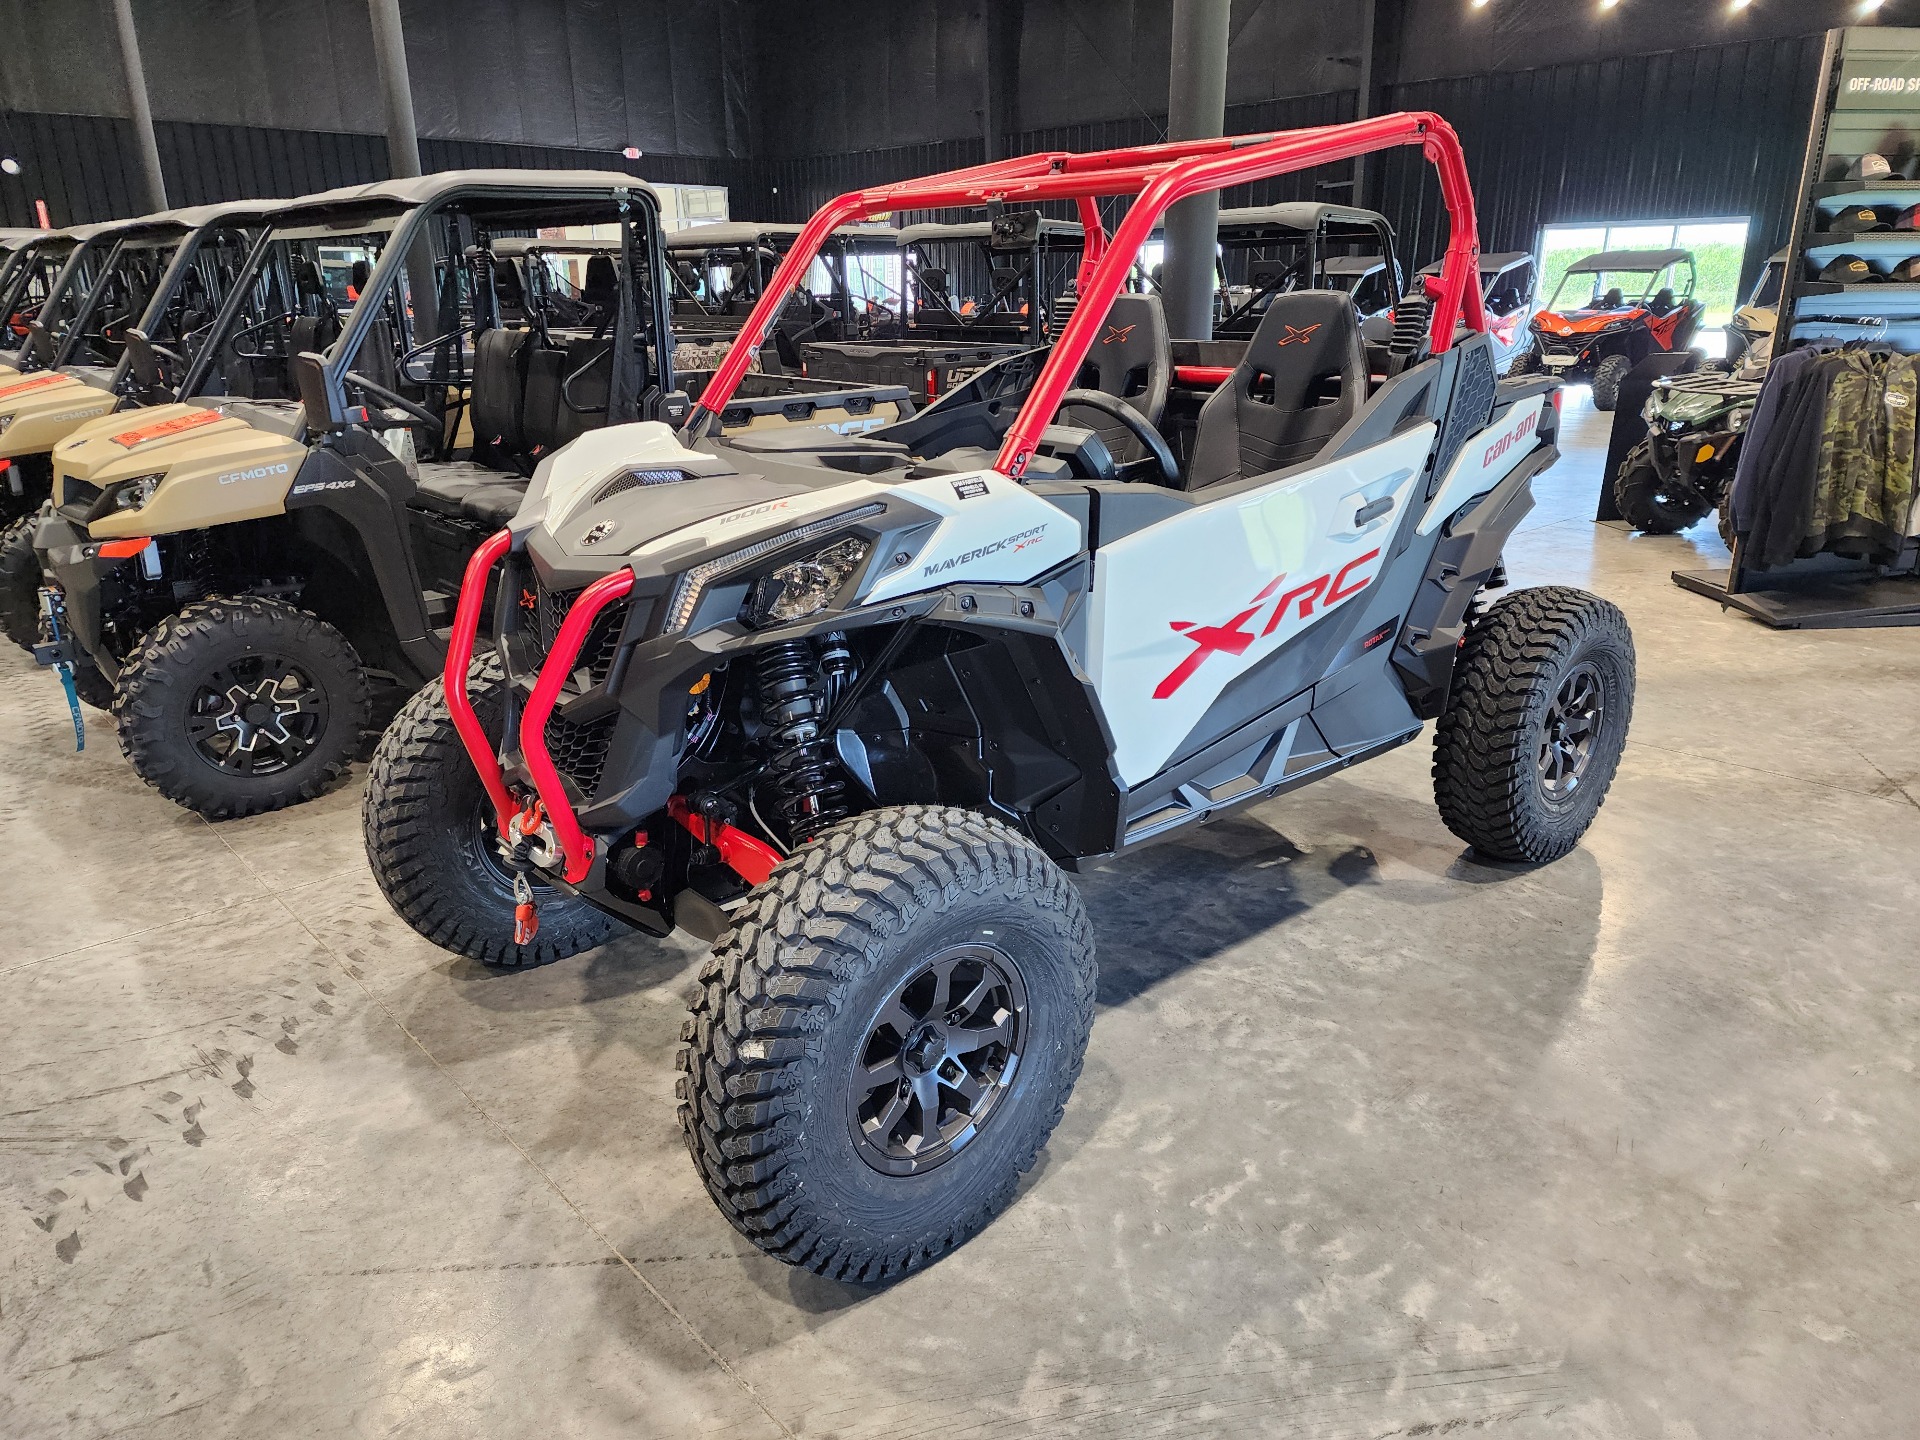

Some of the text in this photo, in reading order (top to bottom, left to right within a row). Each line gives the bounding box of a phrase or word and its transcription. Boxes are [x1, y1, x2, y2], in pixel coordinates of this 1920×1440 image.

[1849, 77, 1905, 90] OFF-ROAD
[53, 407, 104, 423] CFMOTO
[1482, 410, 1537, 469] can-am
[218, 463, 289, 485] CFMOTO
[923, 523, 1048, 577] MAVERICK SPORT
[1152, 546, 1381, 699] XRC
[1364, 633, 1384, 649] ROTAX
